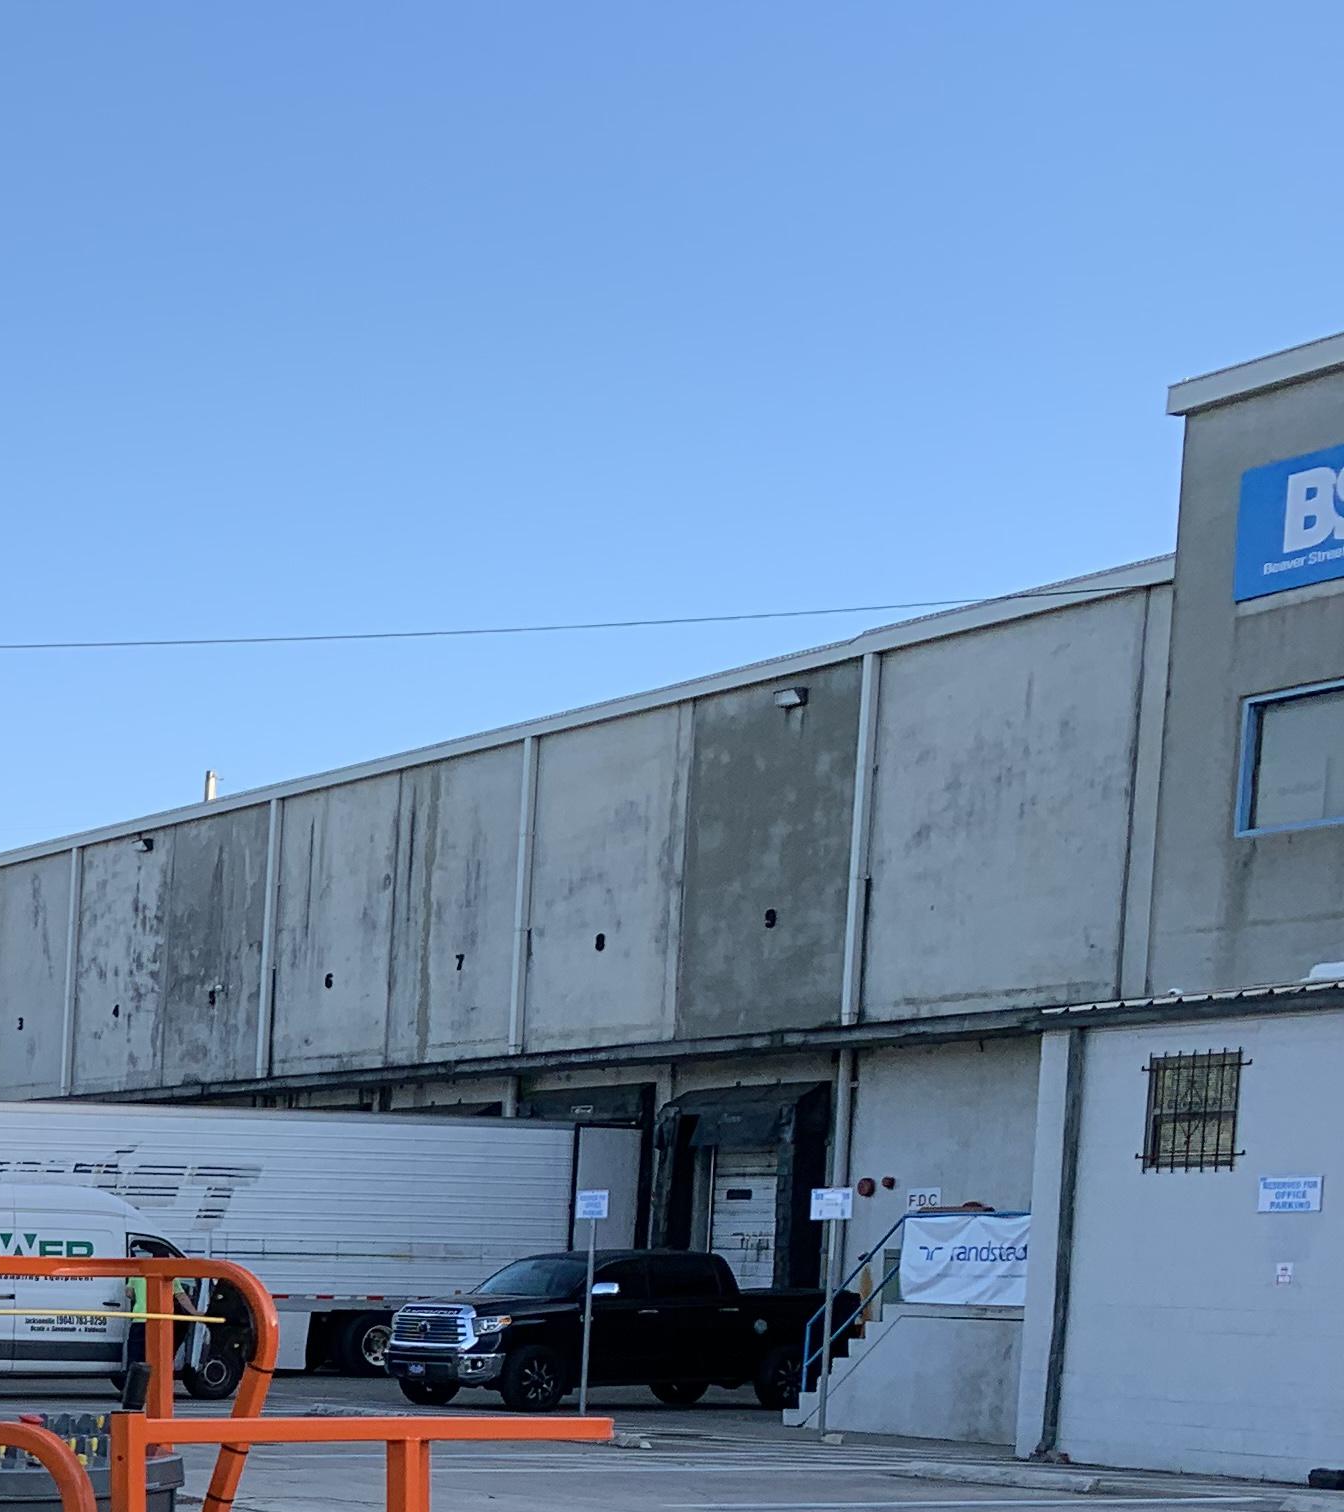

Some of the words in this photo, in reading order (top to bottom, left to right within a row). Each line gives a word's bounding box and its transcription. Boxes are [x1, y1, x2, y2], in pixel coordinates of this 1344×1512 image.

[1283, 467, 1344, 553] B
[1263, 555, 1306, 576] Beaver
[1308, 546, 1344, 565] Stree
[765, 909, 776, 929] 9
[456, 953, 464, 971] 7
[324, 973, 333, 989] 6
[112, 1004, 119, 1018] 4
[17, 1017, 24, 1031] 3
[1275, 1190, 1307, 1200] OFFICE
[1269, 1201, 1311, 1210] PARKING
[951, 1241, 1028, 1262] randstad
